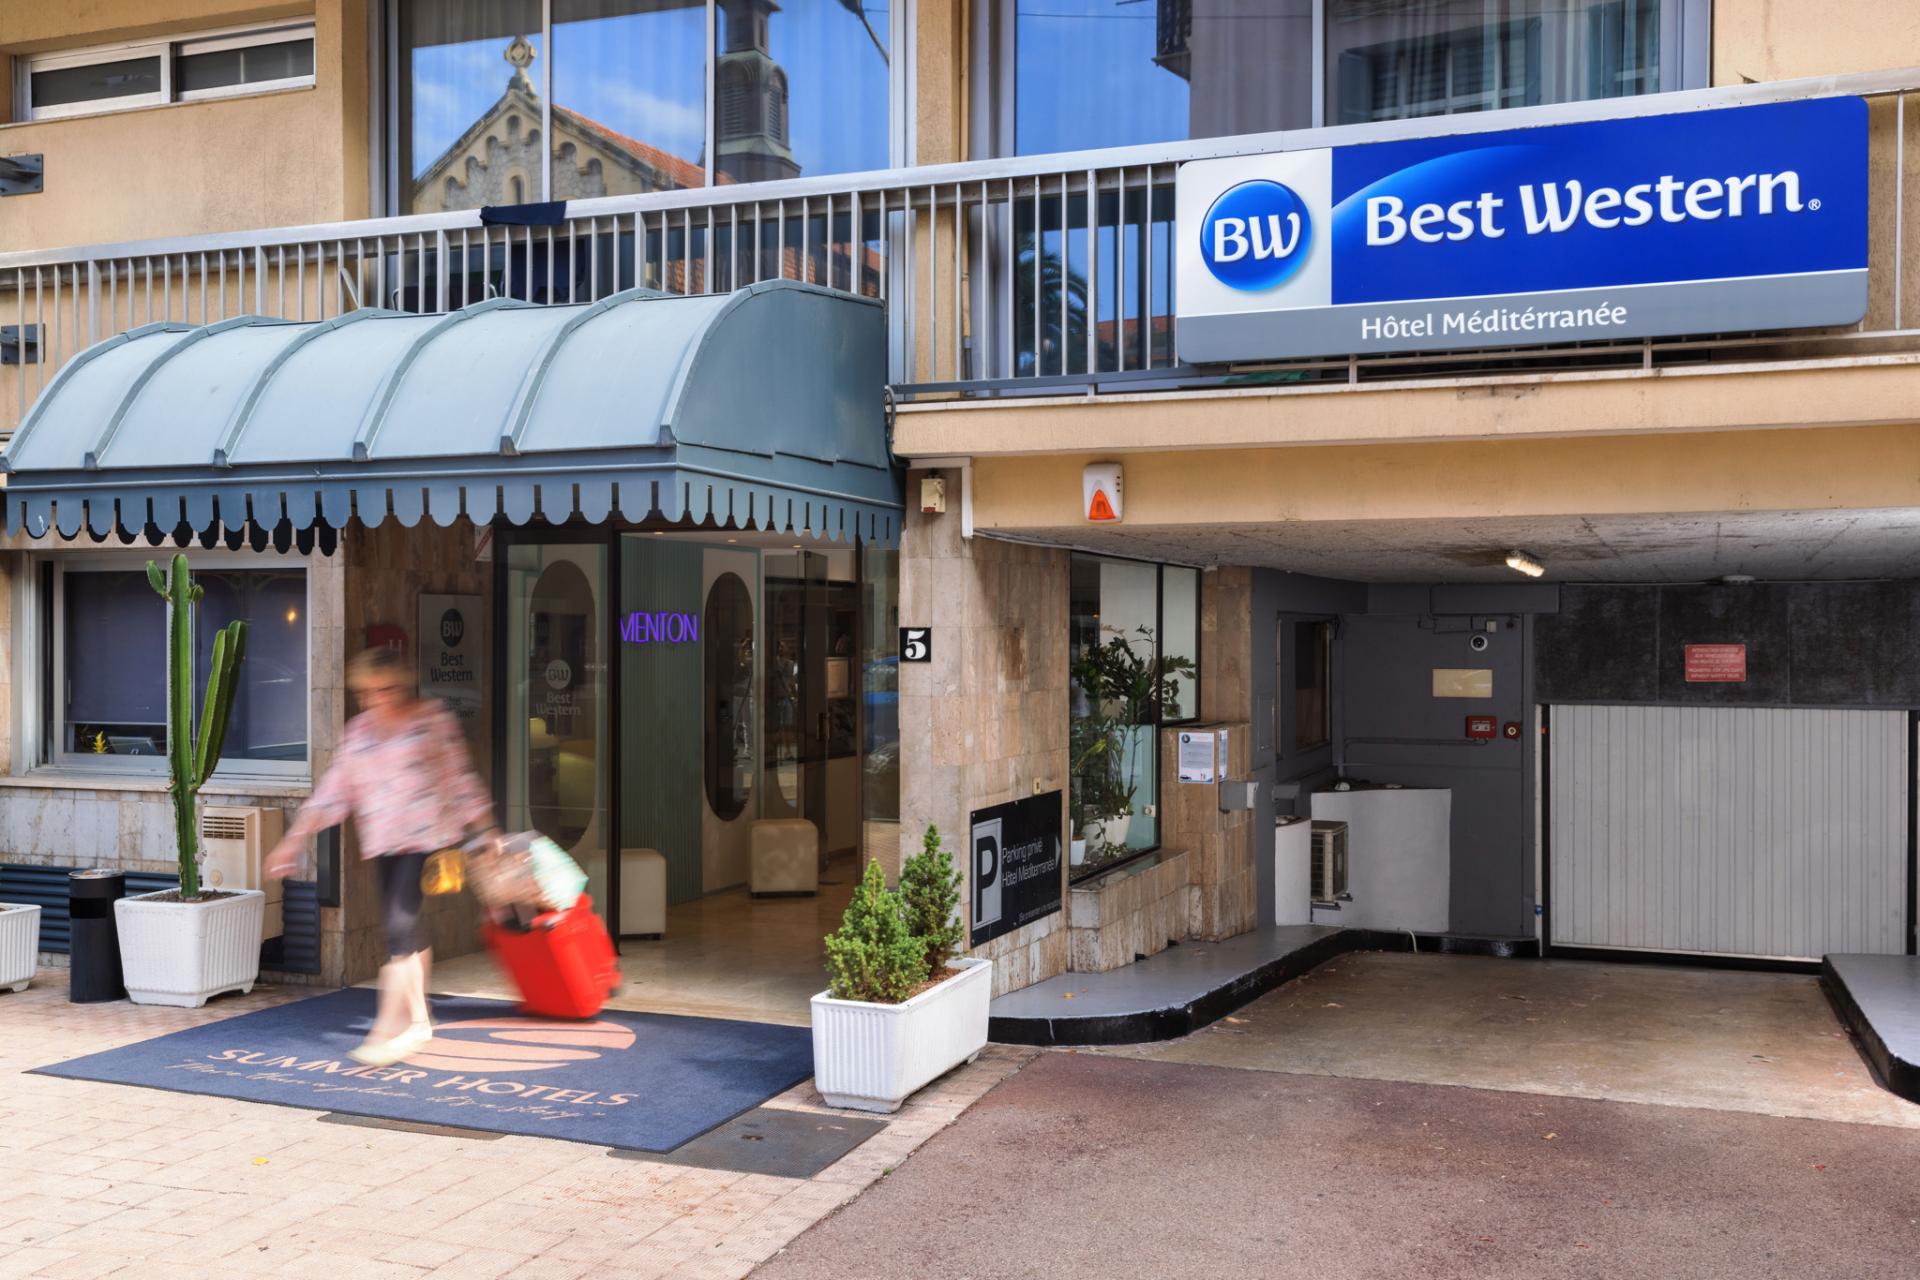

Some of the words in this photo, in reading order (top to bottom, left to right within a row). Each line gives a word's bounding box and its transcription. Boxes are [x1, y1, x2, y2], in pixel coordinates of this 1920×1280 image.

[1214, 211, 1301, 262] BW
[1366, 193, 1505, 247] Best
[1360, 312, 1434, 340] Hôtel
[1442, 301, 1628, 337] Méditérranée
[441, 652, 464, 667] Best
[904, 630, 927, 659] 5
[1002, 843, 1027, 864] Parking
[206, 1049, 428, 1084] SUMMER
[432, 1075, 640, 1106] HOTELS
